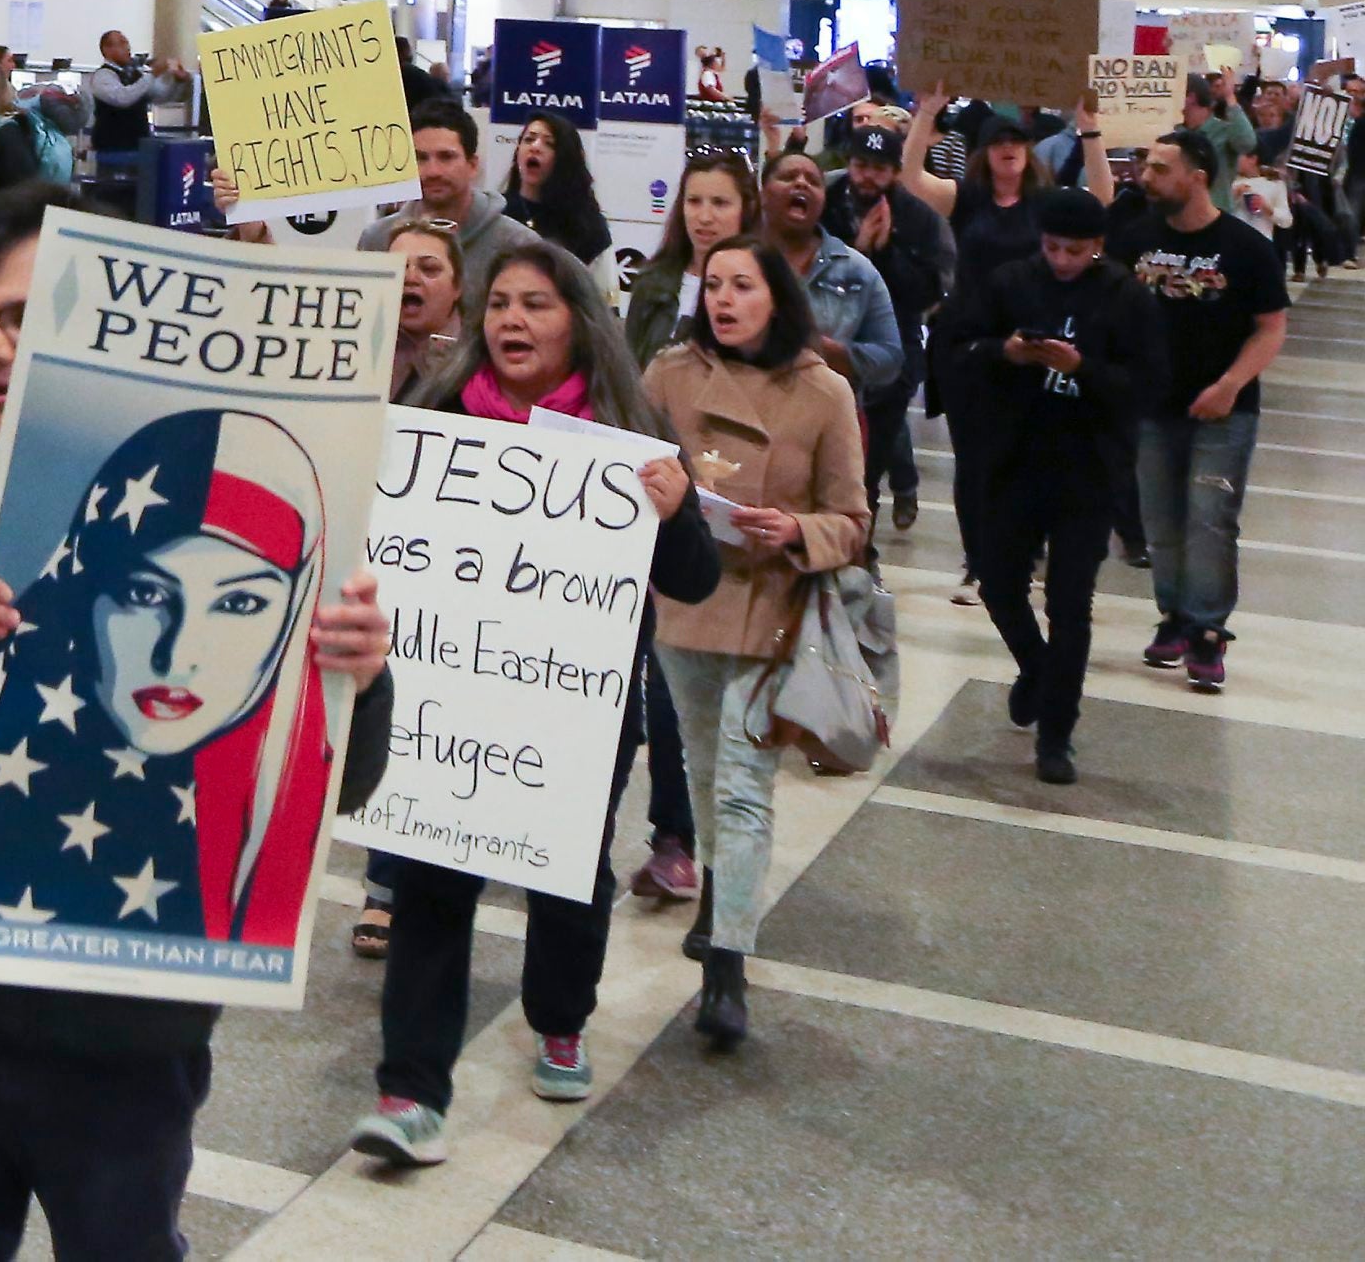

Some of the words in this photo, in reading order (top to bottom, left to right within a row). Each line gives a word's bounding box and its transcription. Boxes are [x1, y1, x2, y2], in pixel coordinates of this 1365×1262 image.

[212, 19, 383, 84] IMMIGRANTS
[1094, 58, 1128, 76] NO
[1132, 58, 1178, 77] BAN
[261, 84, 337, 130] HAVE
[502, 90, 584, 109] LATAM
[599, 90, 671, 106] LATAM
[1092, 80, 1118, 95] NO
[1120, 80, 1172, 94] WALL
[1296, 90, 1349, 148] NO!
[350, 123, 411, 178] TOO
[169, 210, 201, 227] LATAM
[97, 254, 227, 319] WE
[249, 281, 364, 331] THE
[87, 307, 361, 382] PEOPLE
[376, 427, 641, 530] JESUS
[455, 546, 484, 583] a
[505, 542, 640, 625] brown
[473, 619, 627, 709] Eastern
[395, 796, 551, 869] Immigrants
[129, 939, 206, 967] THAN
[212, 947, 286, 975] FEAR
